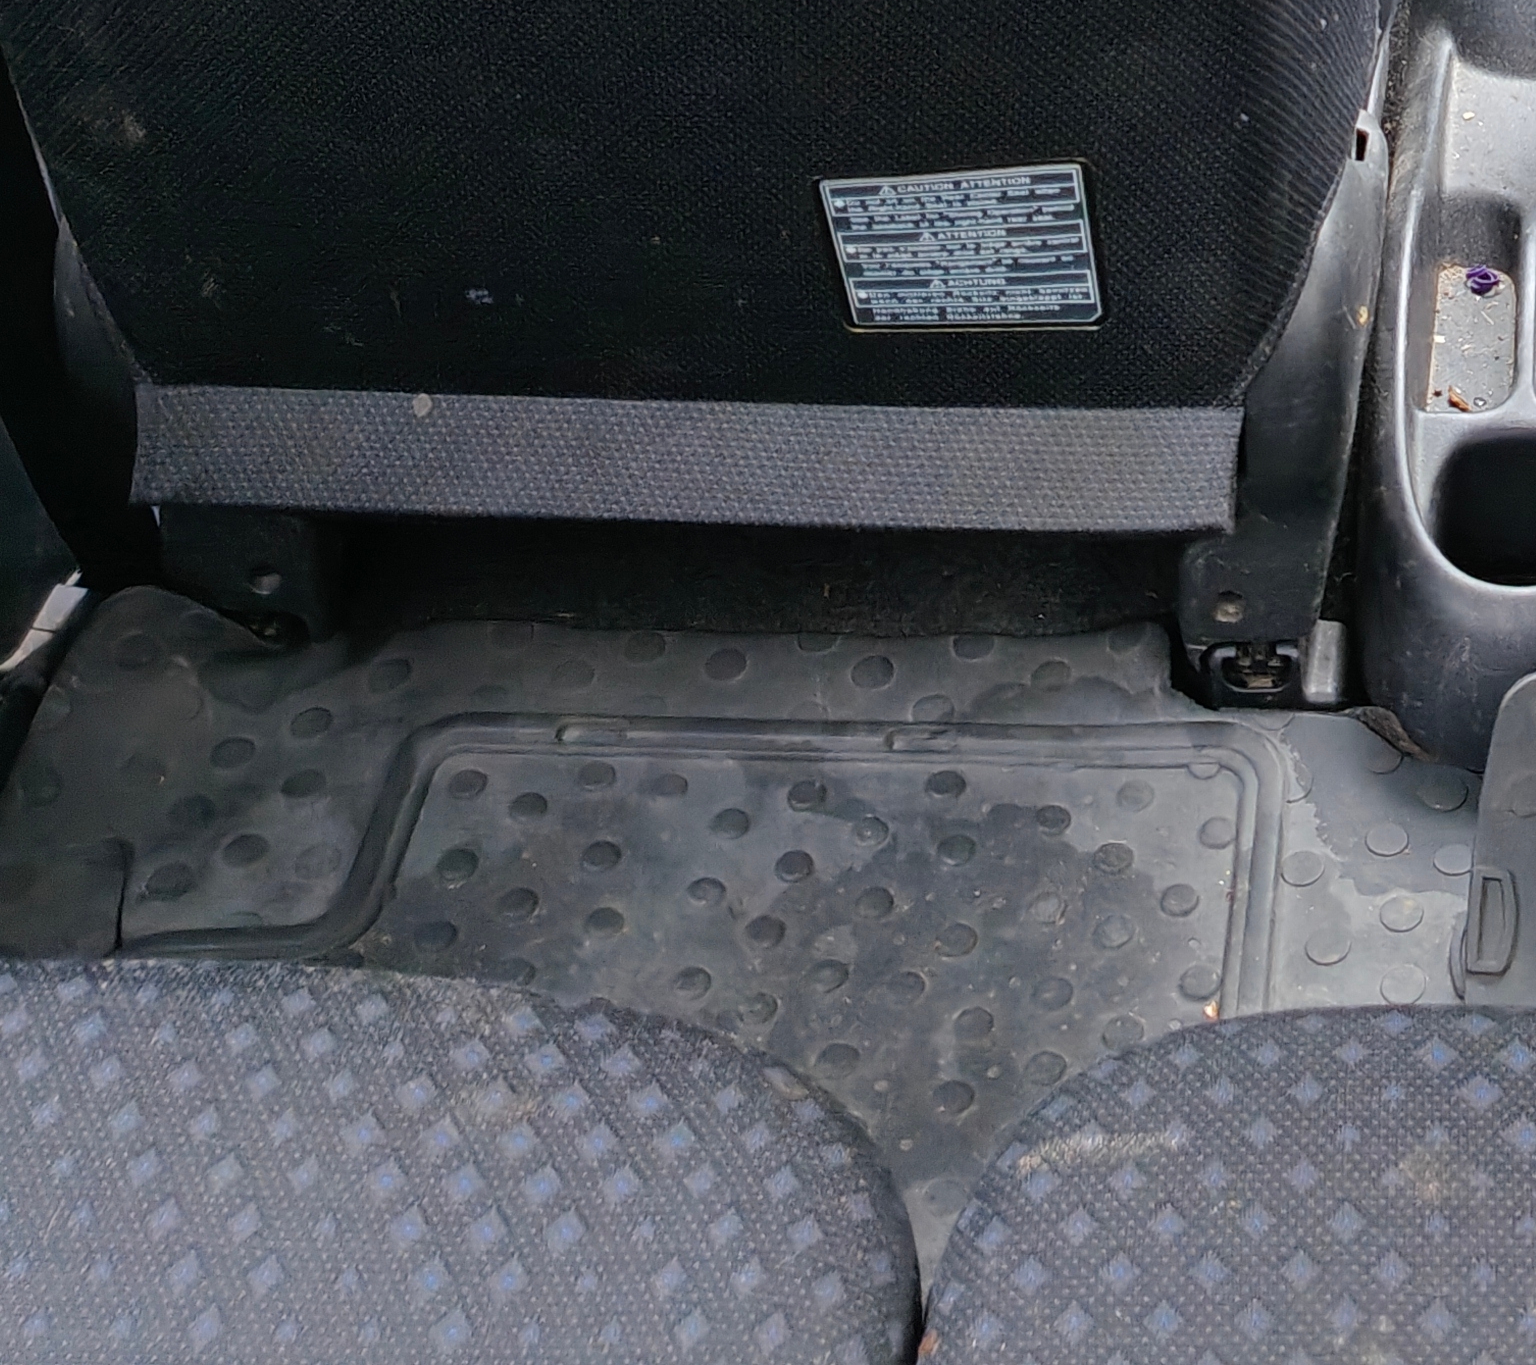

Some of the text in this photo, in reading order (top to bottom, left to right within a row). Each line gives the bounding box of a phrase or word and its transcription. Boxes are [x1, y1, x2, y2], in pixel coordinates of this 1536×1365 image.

[897, 175, 1032, 193] CAUTION ATTENTION
[937, 229, 1008, 240] ATTENTION
